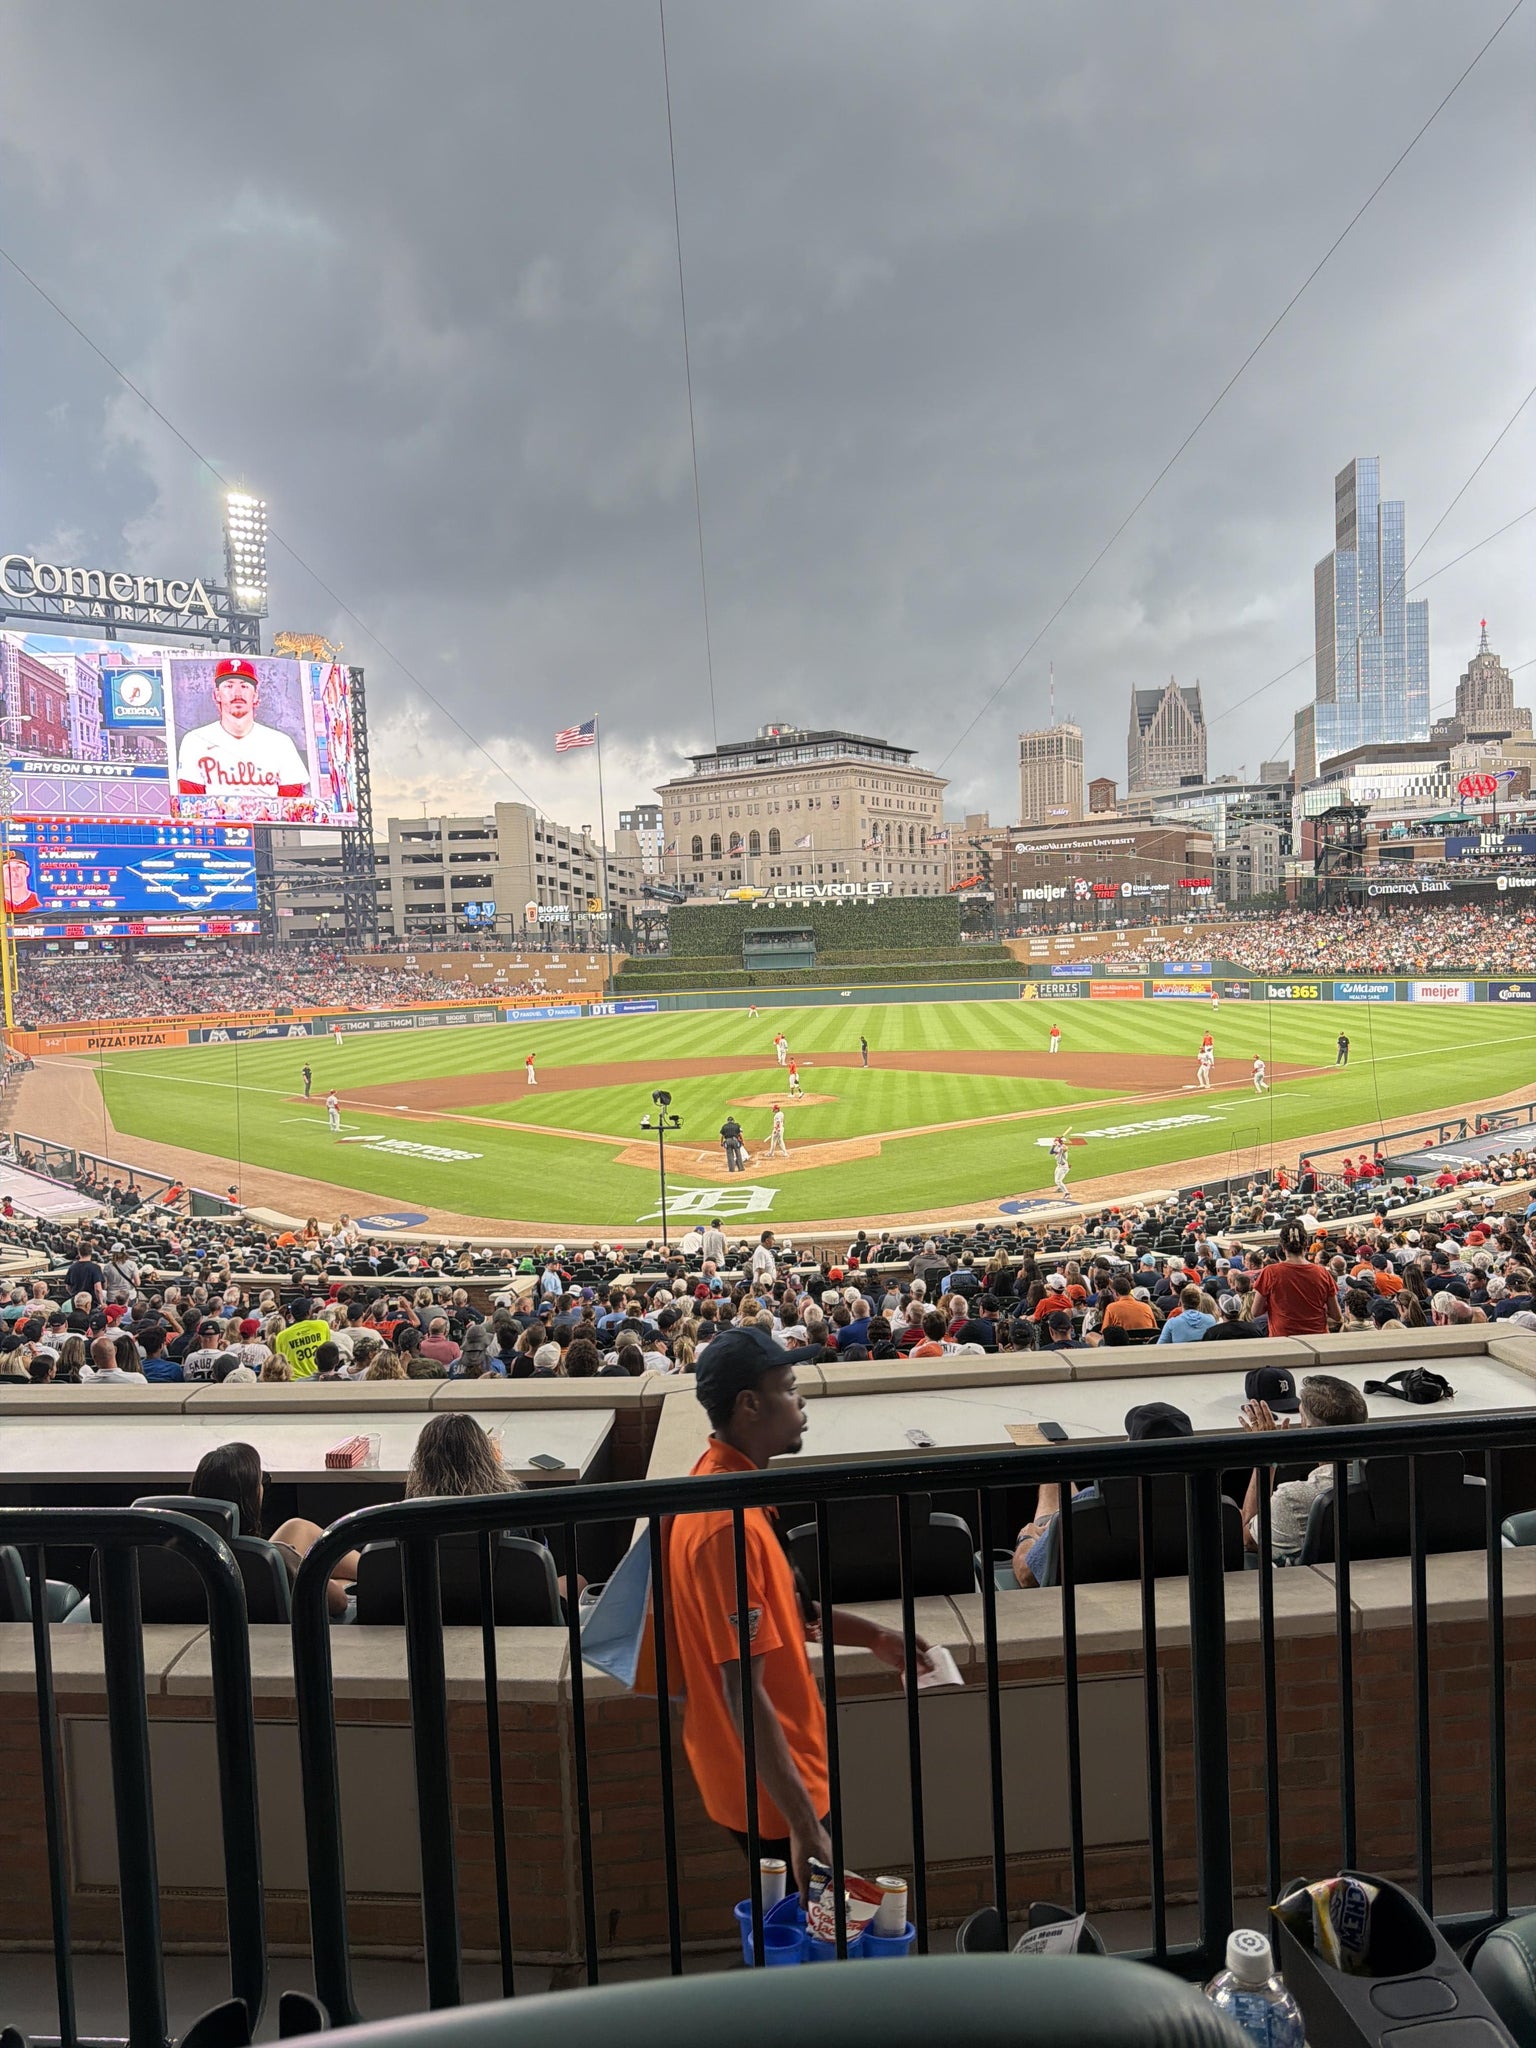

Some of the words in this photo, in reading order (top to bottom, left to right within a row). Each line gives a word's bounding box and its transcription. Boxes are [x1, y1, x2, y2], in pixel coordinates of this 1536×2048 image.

[62, 598, 163, 624] PARK
[24, 762, 80, 774] BRYSON
[82, 764, 135, 776] STOTT
[1460, 775, 1498, 797] AAA
[1048, 842, 1072, 850] VALLEY
[1073, 840, 1093, 848] STATE
[1093, 837, 1136, 847] UNIVERSITY
[1480, 833, 1505, 847] Lite
[774, 881, 893, 899] CHEVROLET
[1092, 883, 1119, 891] BELLE
[1190, 886, 1212, 896] LAW
[1421, 880, 1451, 893] Bank
[1022, 884, 1067, 902] meijer
[1095, 890, 1116, 898] TIRE
[538, 905, 570, 913] BIGGBY
[752, 897, 875, 910] FOUNTAIN
[538, 915, 570, 923] COFFEE
[577, 912, 613, 921] BETMGM
[14, 924, 45, 938] meijer
[1183, 926, 1194, 934] 42
[1117, 932, 1126, 941] 10
[406, 956, 416, 964] 23
[552, 955, 559, 963] 16
[1040, 984, 1078, 993] FERRIS
[1268, 983, 1318, 999] bet365
[1353, 983, 1388, 994] McLaren
[1421, 984, 1460, 1000] meijer
[1498, 989, 1532, 999] Corona
[555, 1008, 576, 1016] FANDUEL
[593, 1004, 616, 1015] DTE
[336, 1021, 370, 1031] ETMGM
[381, 1018, 412, 1029] BETMGM
[87, 1035, 126, 1049] PIZZA!
[128, 1033, 166, 1047] PIZZA!
[375, 1138, 484, 1160] VICTORS
[289, 1333, 322, 1349] VENDOR
[189, 1357, 212, 1374] SKUB
